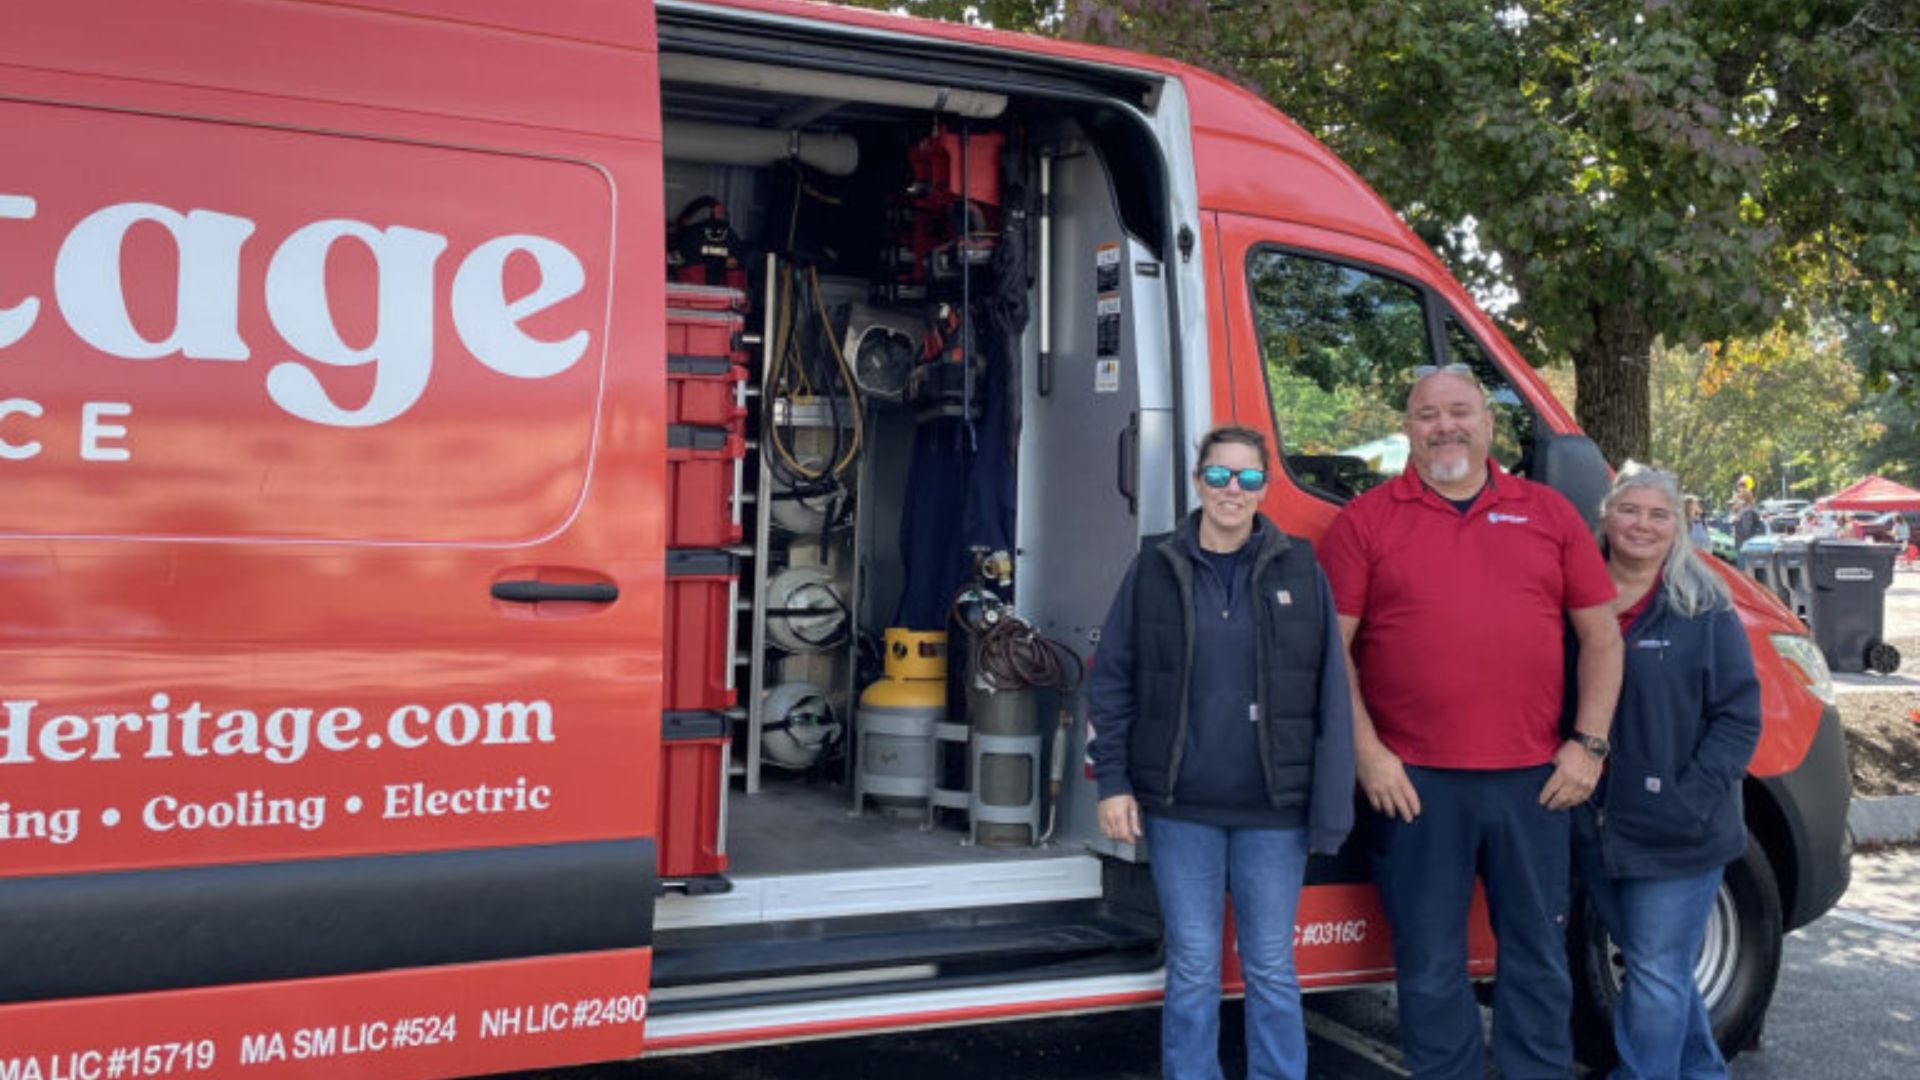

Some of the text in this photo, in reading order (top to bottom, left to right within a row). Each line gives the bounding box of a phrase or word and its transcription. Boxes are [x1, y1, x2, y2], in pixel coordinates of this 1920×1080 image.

[142, 789, 327, 832] Cooling
[381, 777, 552, 820] Electric
[239, 1013, 456, 1066] MA SM LIC #524
[479, 994, 647, 1040] NH LIC #2490
[51, 1050, 102, 1080] LIC
[107, 1039, 216, 1079] #15719
